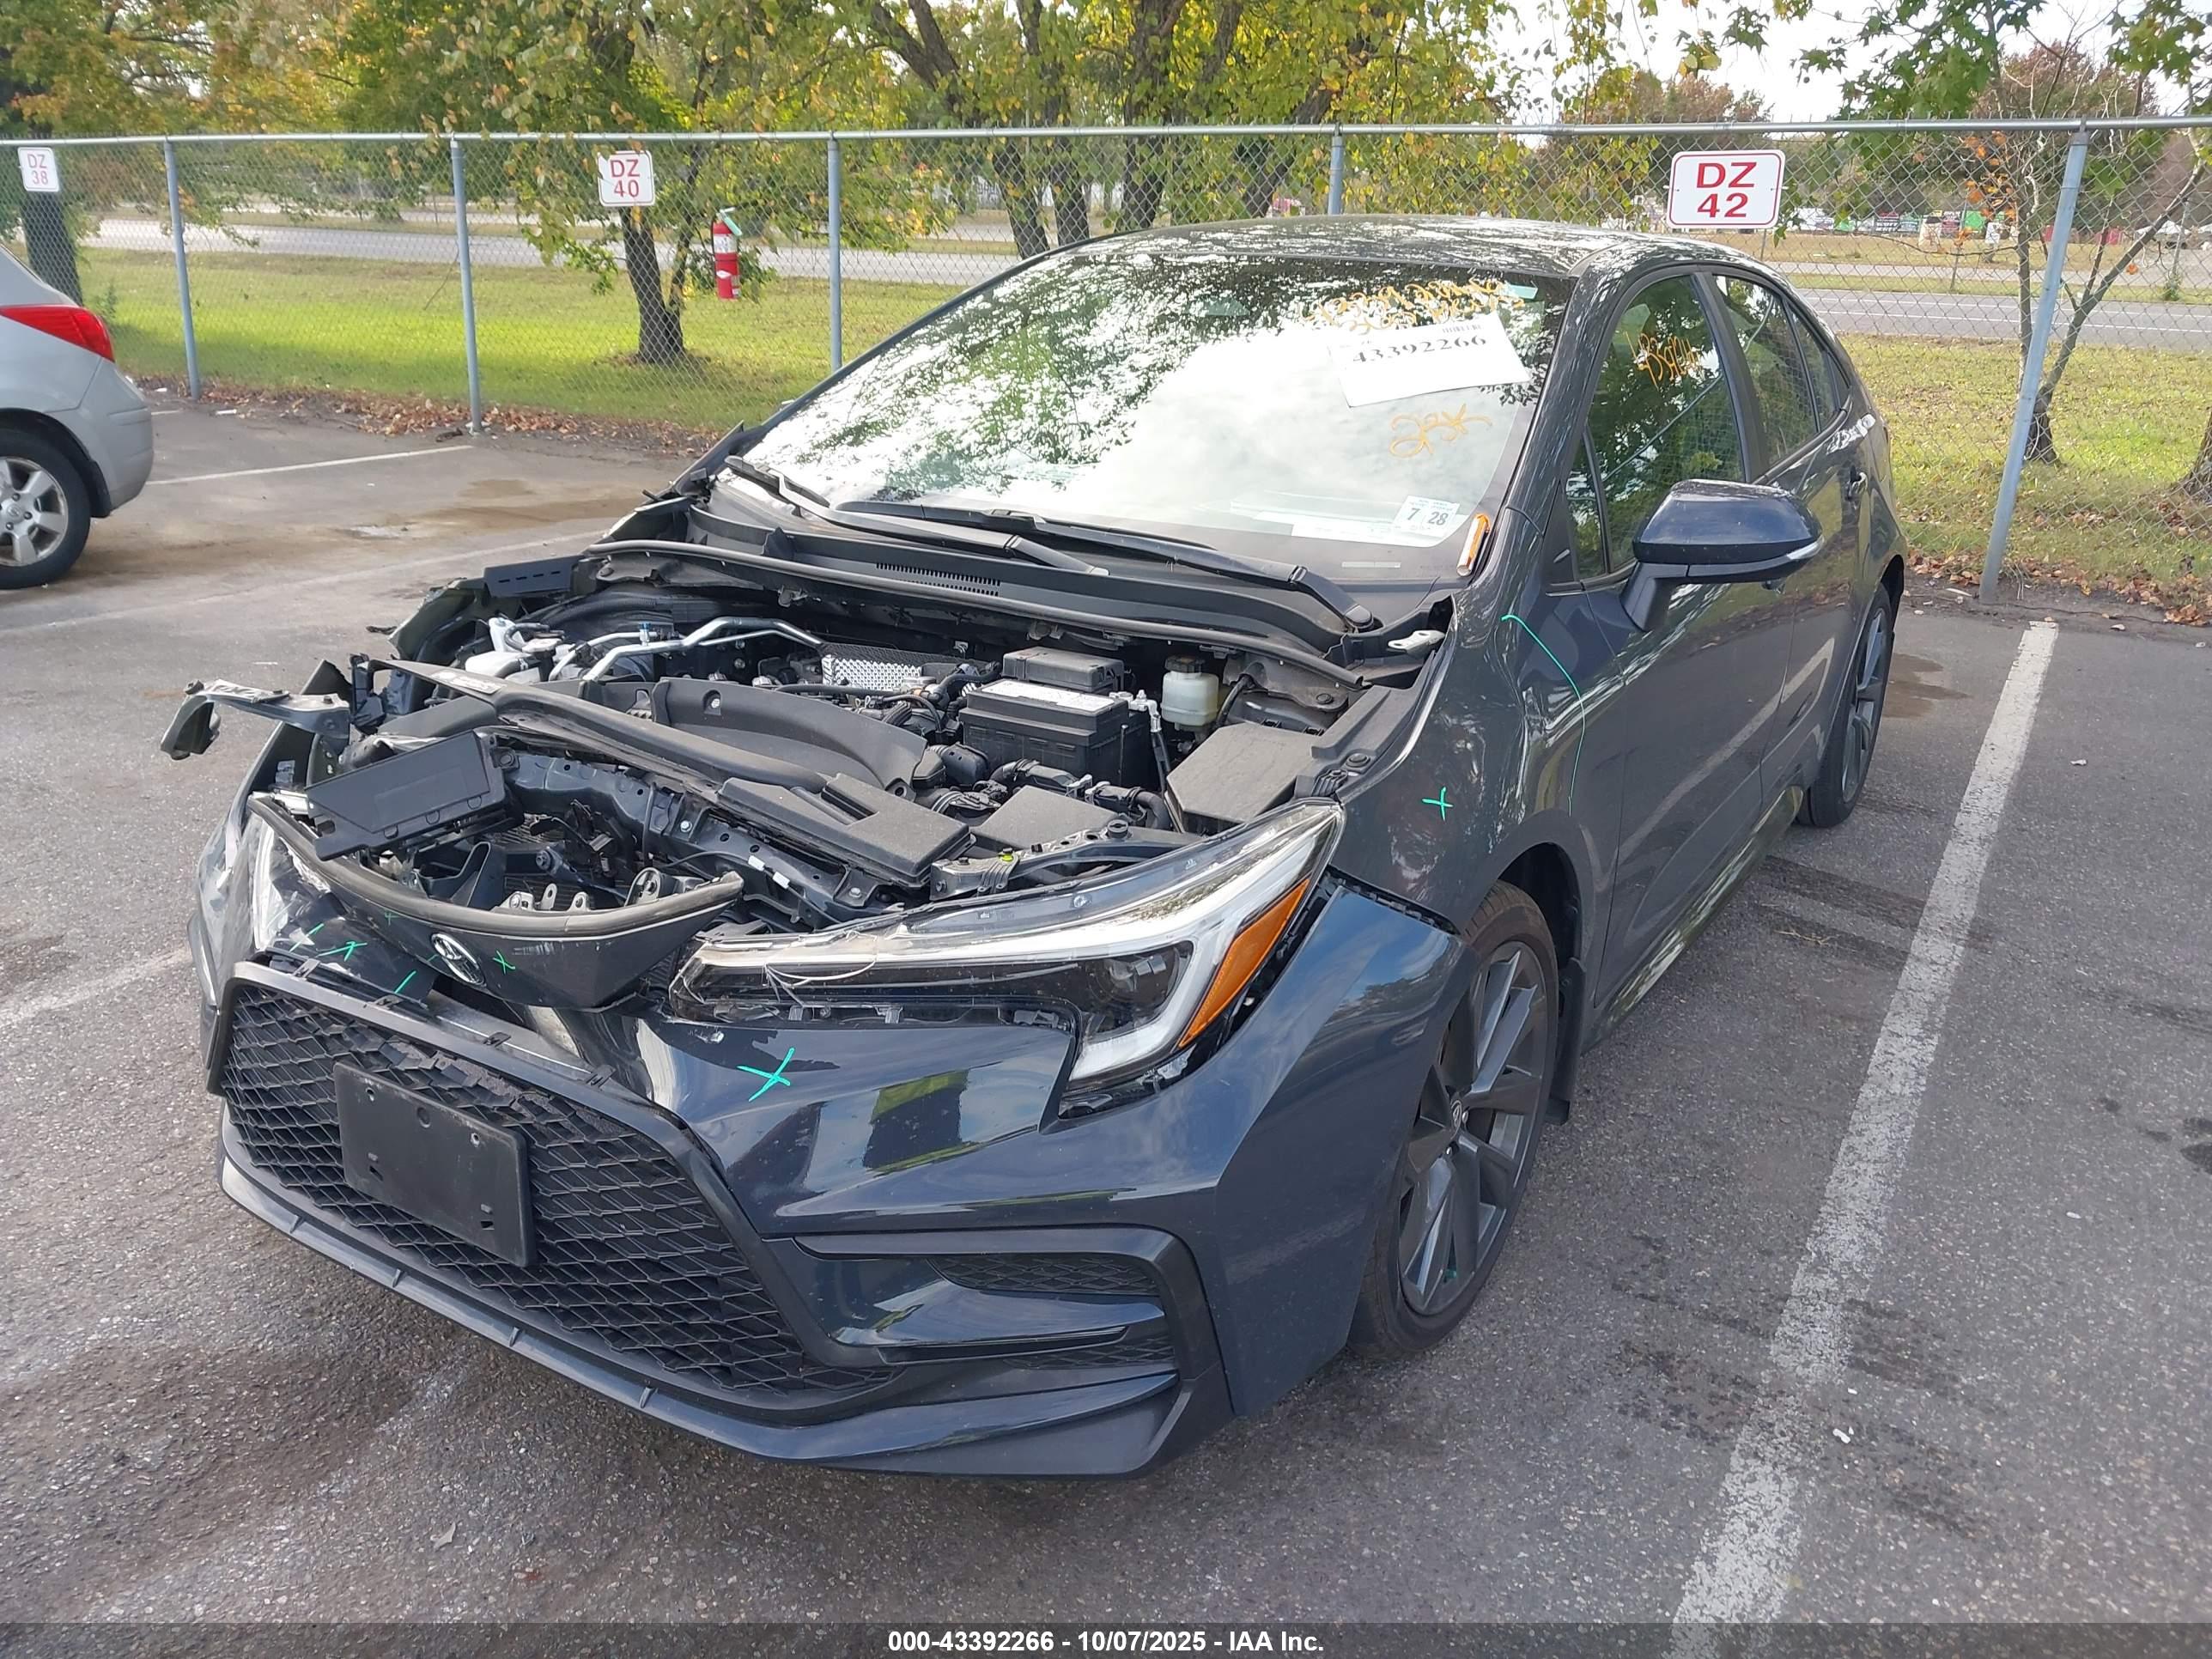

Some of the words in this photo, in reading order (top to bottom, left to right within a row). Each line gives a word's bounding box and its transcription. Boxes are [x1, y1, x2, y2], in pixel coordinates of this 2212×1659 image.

[27, 154, 47, 168] DZ
[610, 159, 641, 178] DZ
[31, 170, 49, 185] 38
[1696, 161, 1757, 188] DZ
[613, 179, 640, 198] 40
[1697, 192, 1748, 218] 42
[1352, 335, 1487, 363] 43392266
[1407, 507, 1421, 520] 7
[1427, 511, 1449, 526] 28
